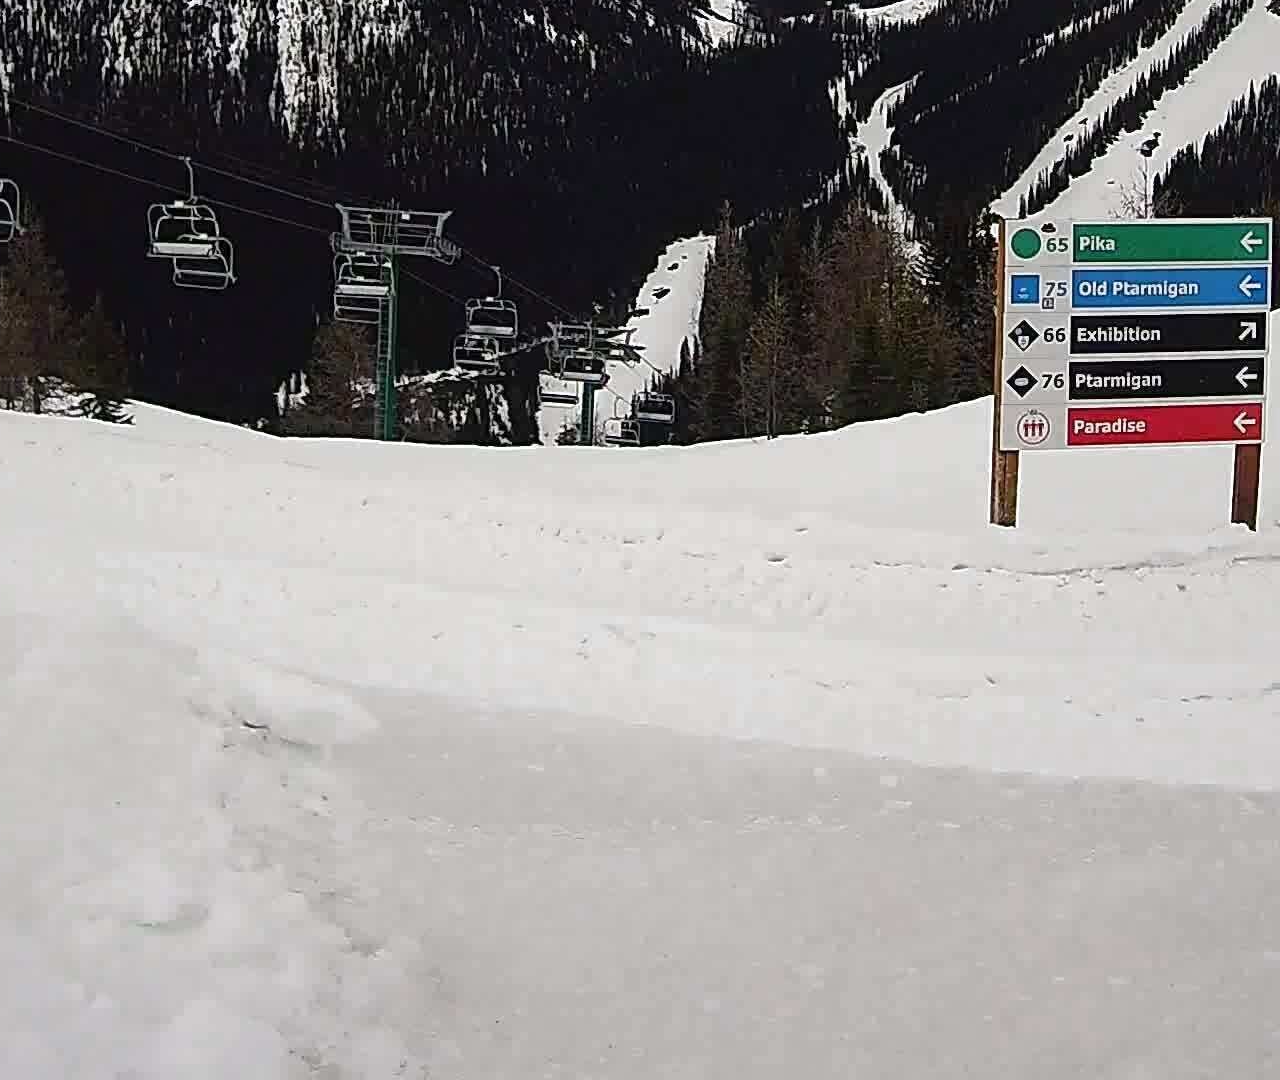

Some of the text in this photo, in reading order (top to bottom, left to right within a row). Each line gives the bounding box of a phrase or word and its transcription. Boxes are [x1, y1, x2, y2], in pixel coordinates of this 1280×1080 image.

[1045, 235, 1116, 253] 65 Pika
[1045, 279, 1199, 298] 75 Old Ptarmigan
[1043, 325, 1161, 343] 66 Exhibition
[1041, 371, 1162, 390] 76 Ptarmigan
[1073, 418, 1147, 435] Paradise
